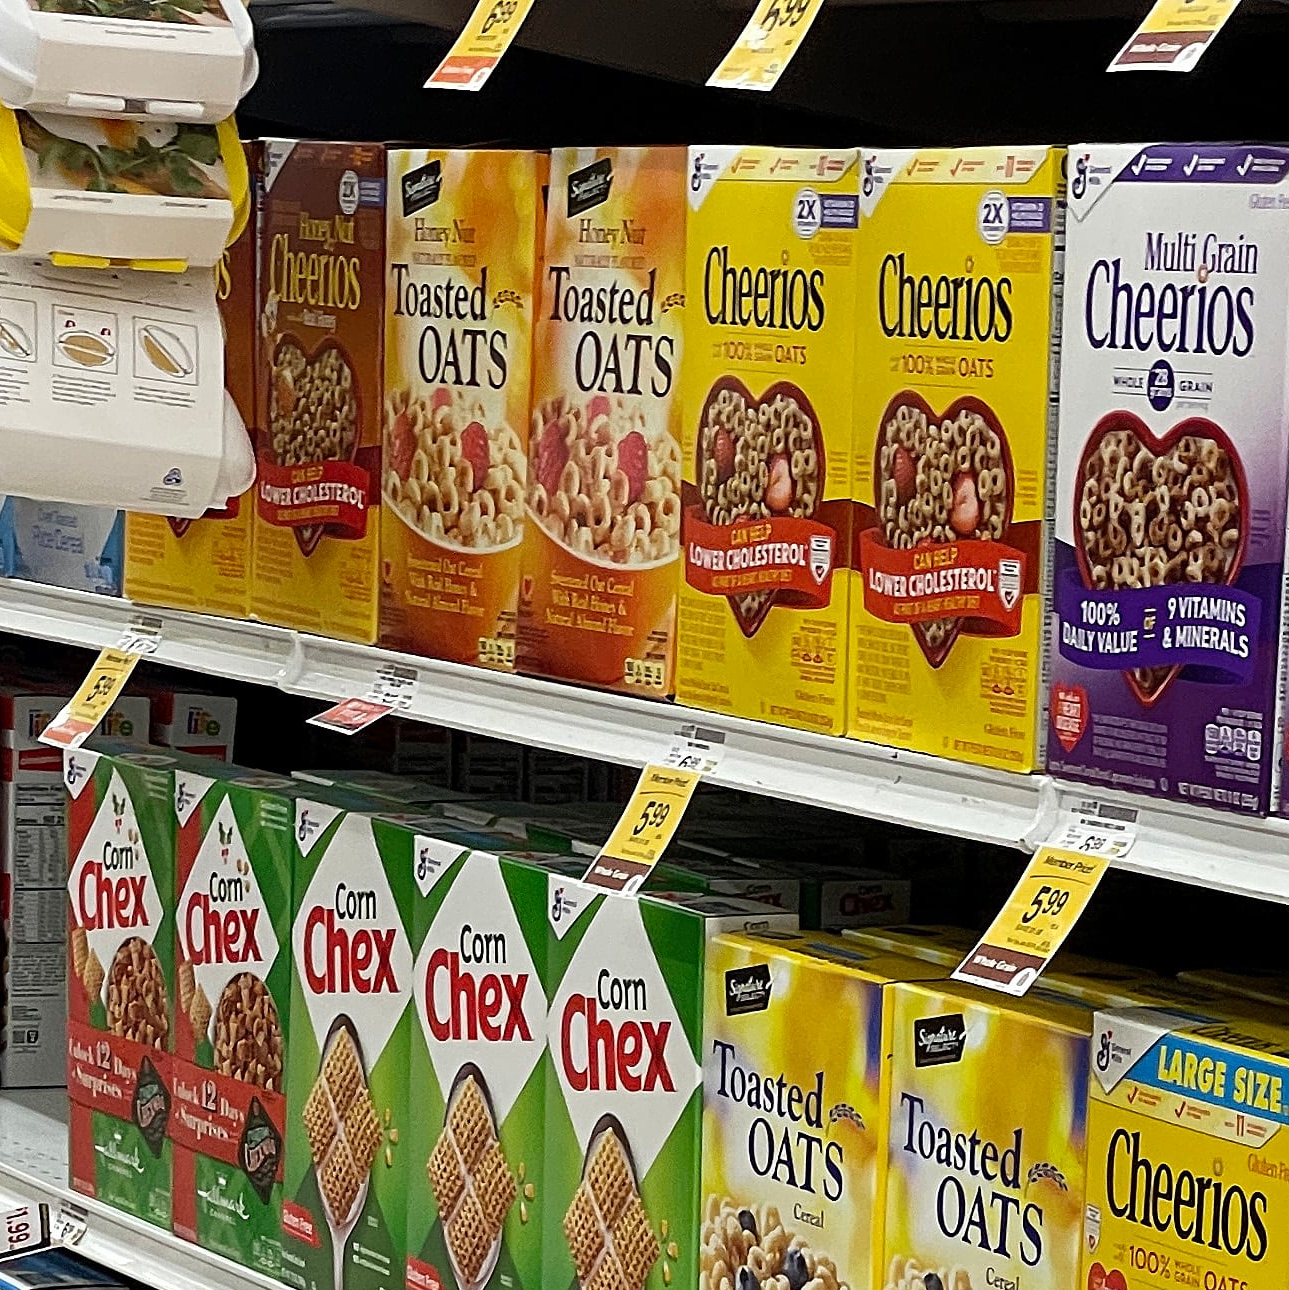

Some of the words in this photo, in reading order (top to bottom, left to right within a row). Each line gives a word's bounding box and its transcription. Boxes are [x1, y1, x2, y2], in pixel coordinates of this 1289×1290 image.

[269, 231, 362, 311] Cheerios
[1145, 232, 1197, 273] Multi
[1203, 237, 1259, 276] Grain
[391, 264, 487, 322] Toasted
[549, 266, 655, 327] Toasted
[705, 246, 825, 333] Cheerios
[879, 252, 1012, 343] Cheerios
[1086, 259, 1255, 358] Cheerios
[419, 325, 509, 391] OATS
[576, 329, 675, 400] OATS
[103, 840, 134, 871] Corn
[209, 871, 243, 903] Corn
[79, 861, 149, 930] Chex
[185, 892, 263, 966] Chex
[336, 882, 377, 921] Corn
[1022, 885, 1069, 923] 599
[303, 905, 401, 997] Chex
[460, 924, 507, 966] Corn
[425, 948, 535, 1043] Chex
[598, 968, 648, 1013] Corn
[561, 993, 678, 1093] Chex
[712, 1041, 825, 1128] Toasted
[1157, 1045, 1225, 1098] LARGE
[1234, 1066, 1282, 1113] SIZE
[748, 1118, 844, 1202] OATS
[900, 1092, 1024, 1189] Toasted
[794, 1203, 825, 1228] Cereal
[937, 1175, 1044, 1267] OATS
[1106, 1127, 1268, 1264] Cheerios
[1129, 1245, 1171, 1278] 100%
